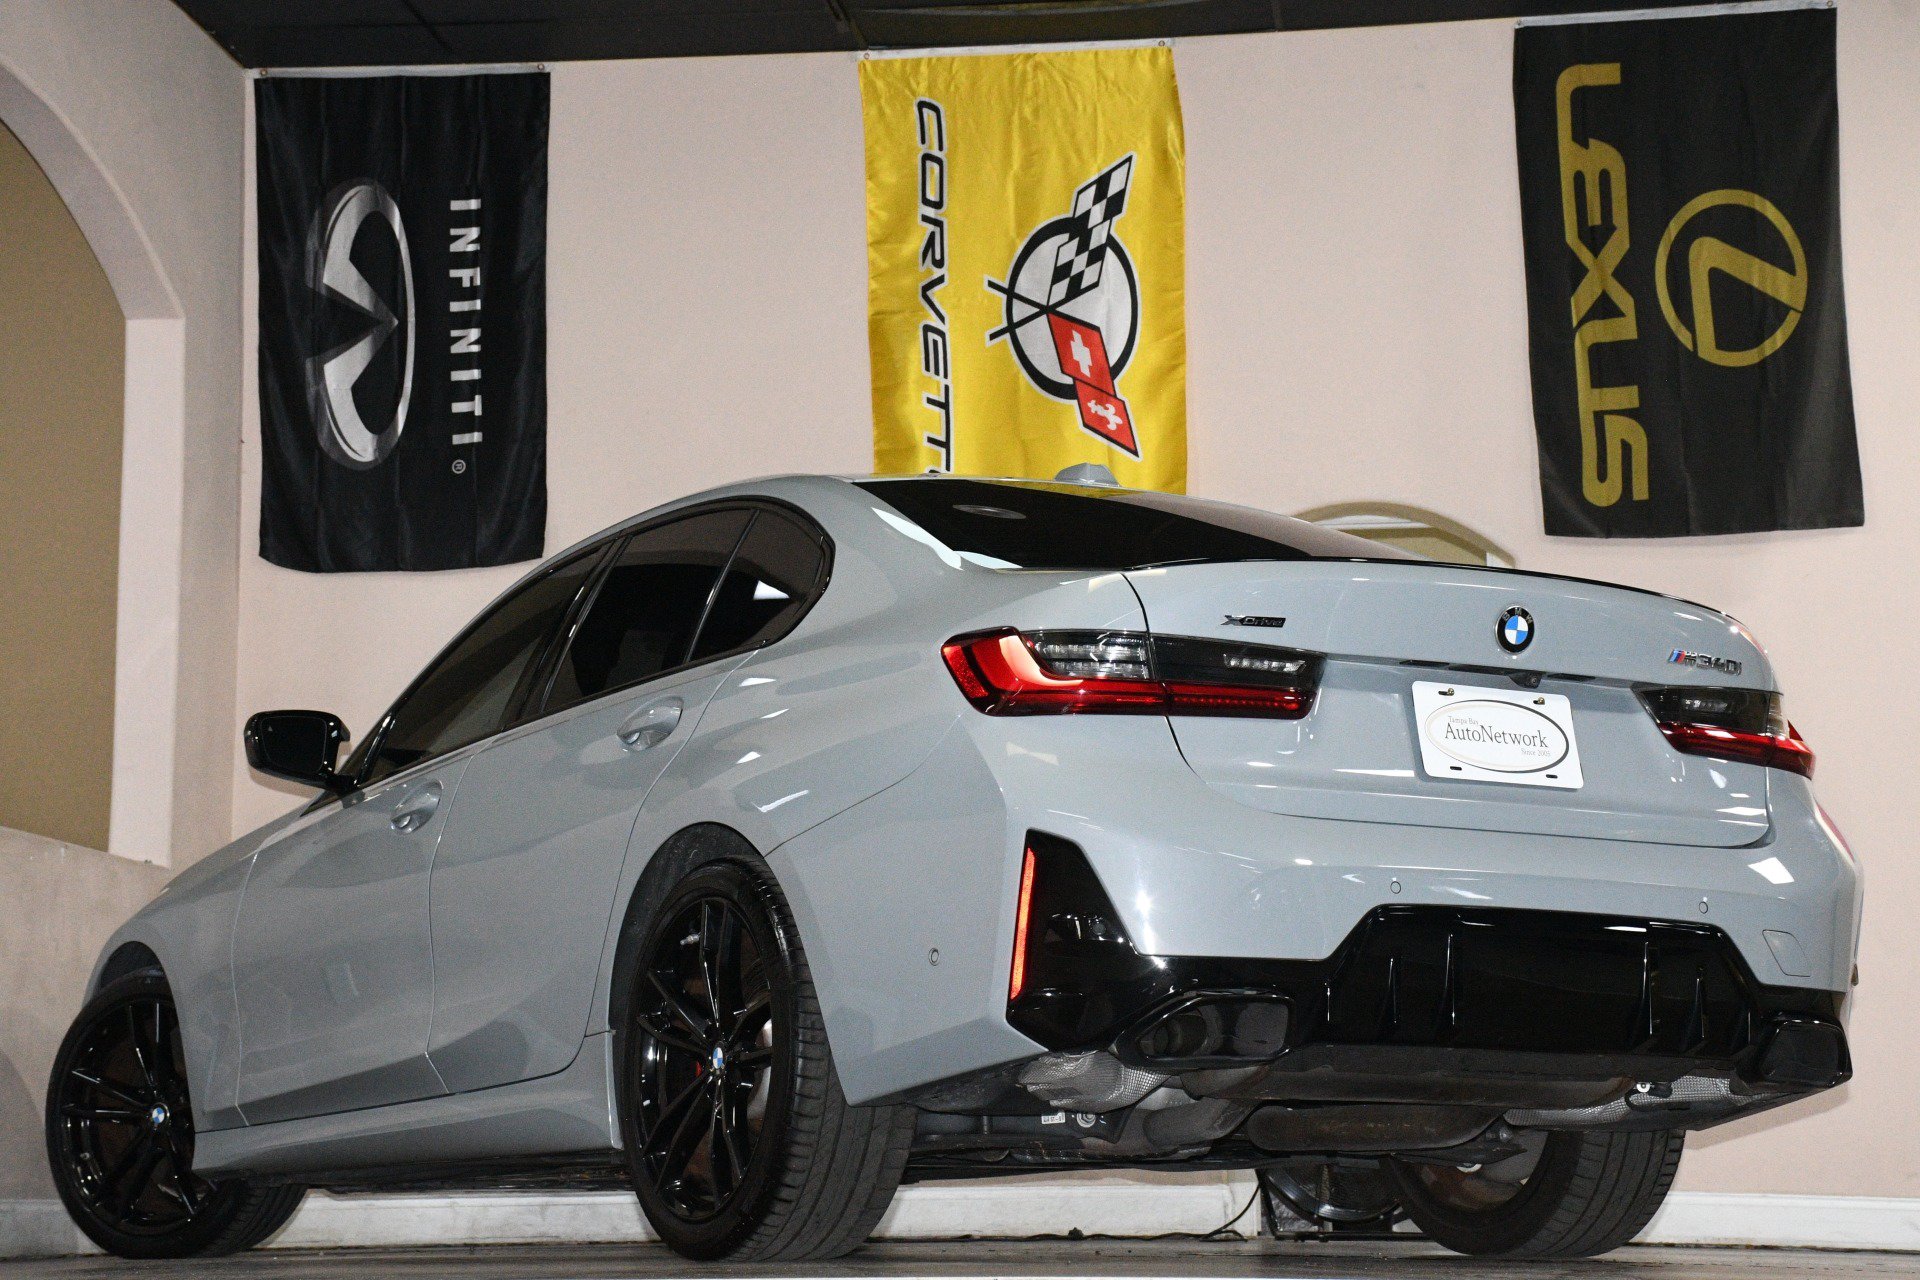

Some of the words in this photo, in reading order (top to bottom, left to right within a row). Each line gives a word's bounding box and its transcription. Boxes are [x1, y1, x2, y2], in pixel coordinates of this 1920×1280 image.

[915, 98, 953, 474] CORVETT
[1556, 62, 1649, 507] LEXUS
[1448, 715, 1468, 726] Tampa
[1468, 717, 1479, 726] Bay
[1445, 722, 1549, 748] AutoNetwork
[1521, 748, 1536, 756] Since
